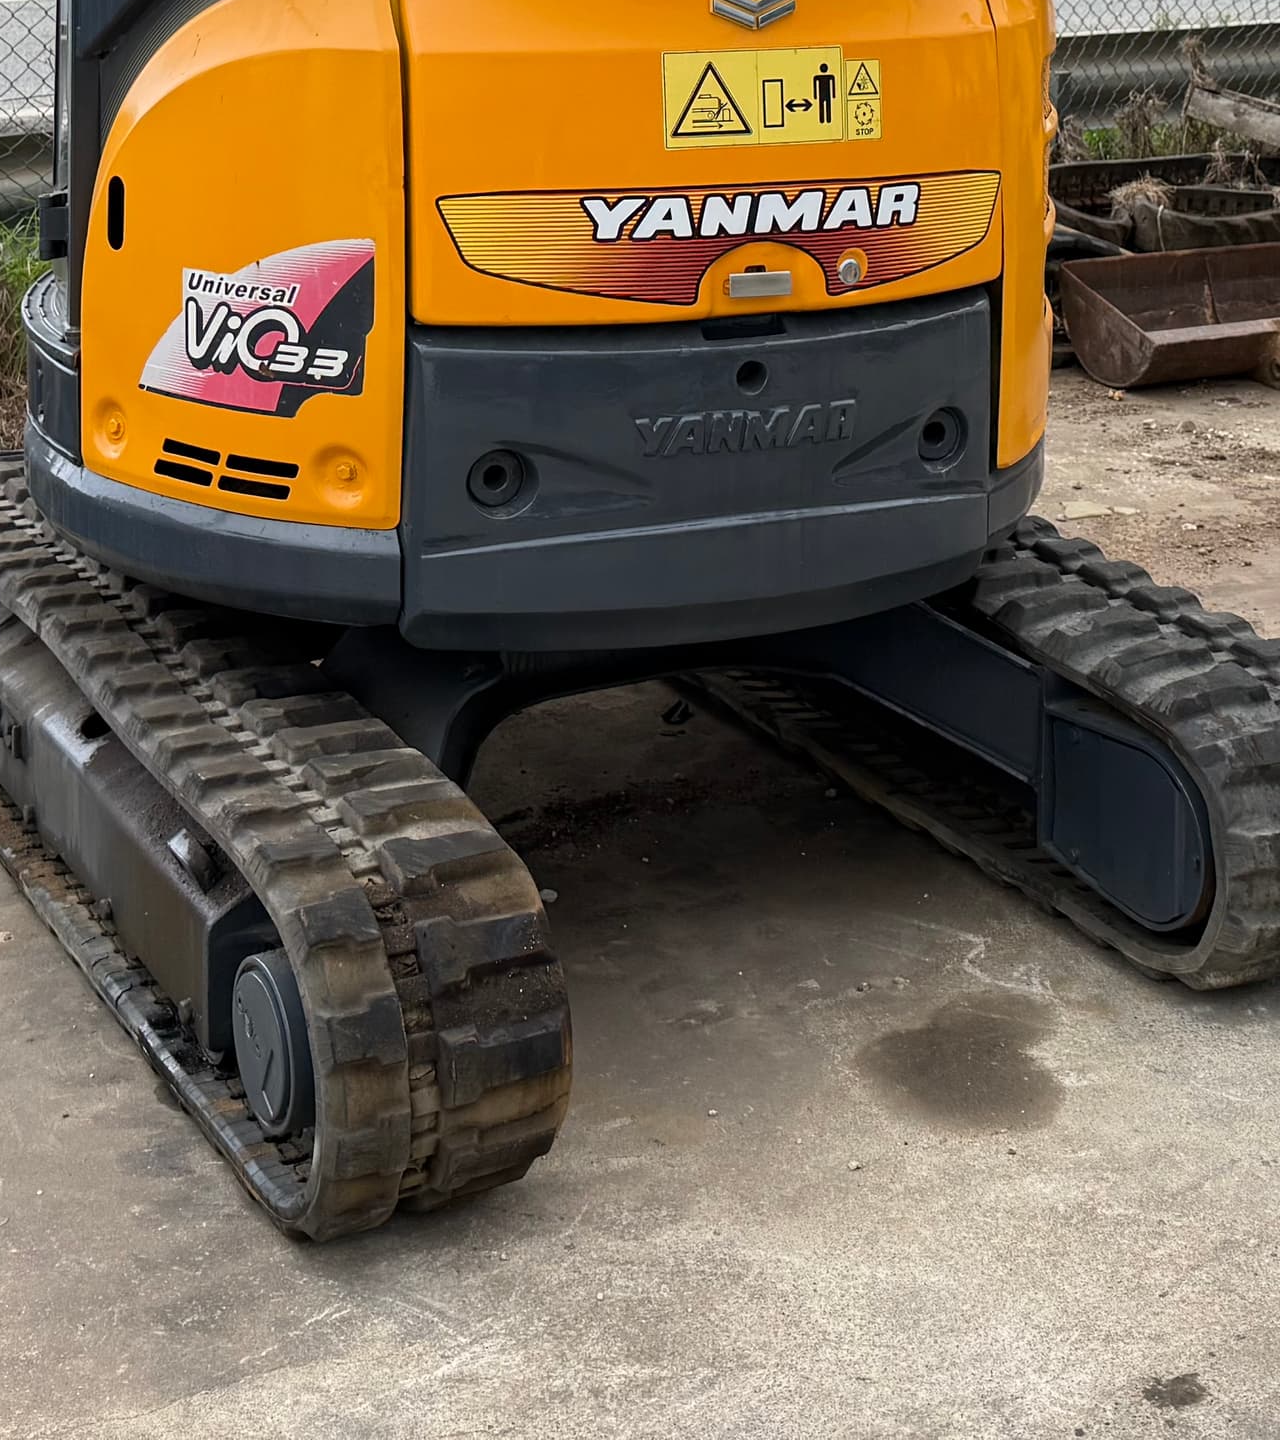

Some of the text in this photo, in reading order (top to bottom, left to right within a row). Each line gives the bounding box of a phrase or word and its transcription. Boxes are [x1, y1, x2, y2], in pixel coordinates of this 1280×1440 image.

[855, 128, 874, 136] STOP
[581, 183, 920, 242] YANMAR
[187, 272, 298, 305] Universal
[634, 399, 857, 457] YANMAR
